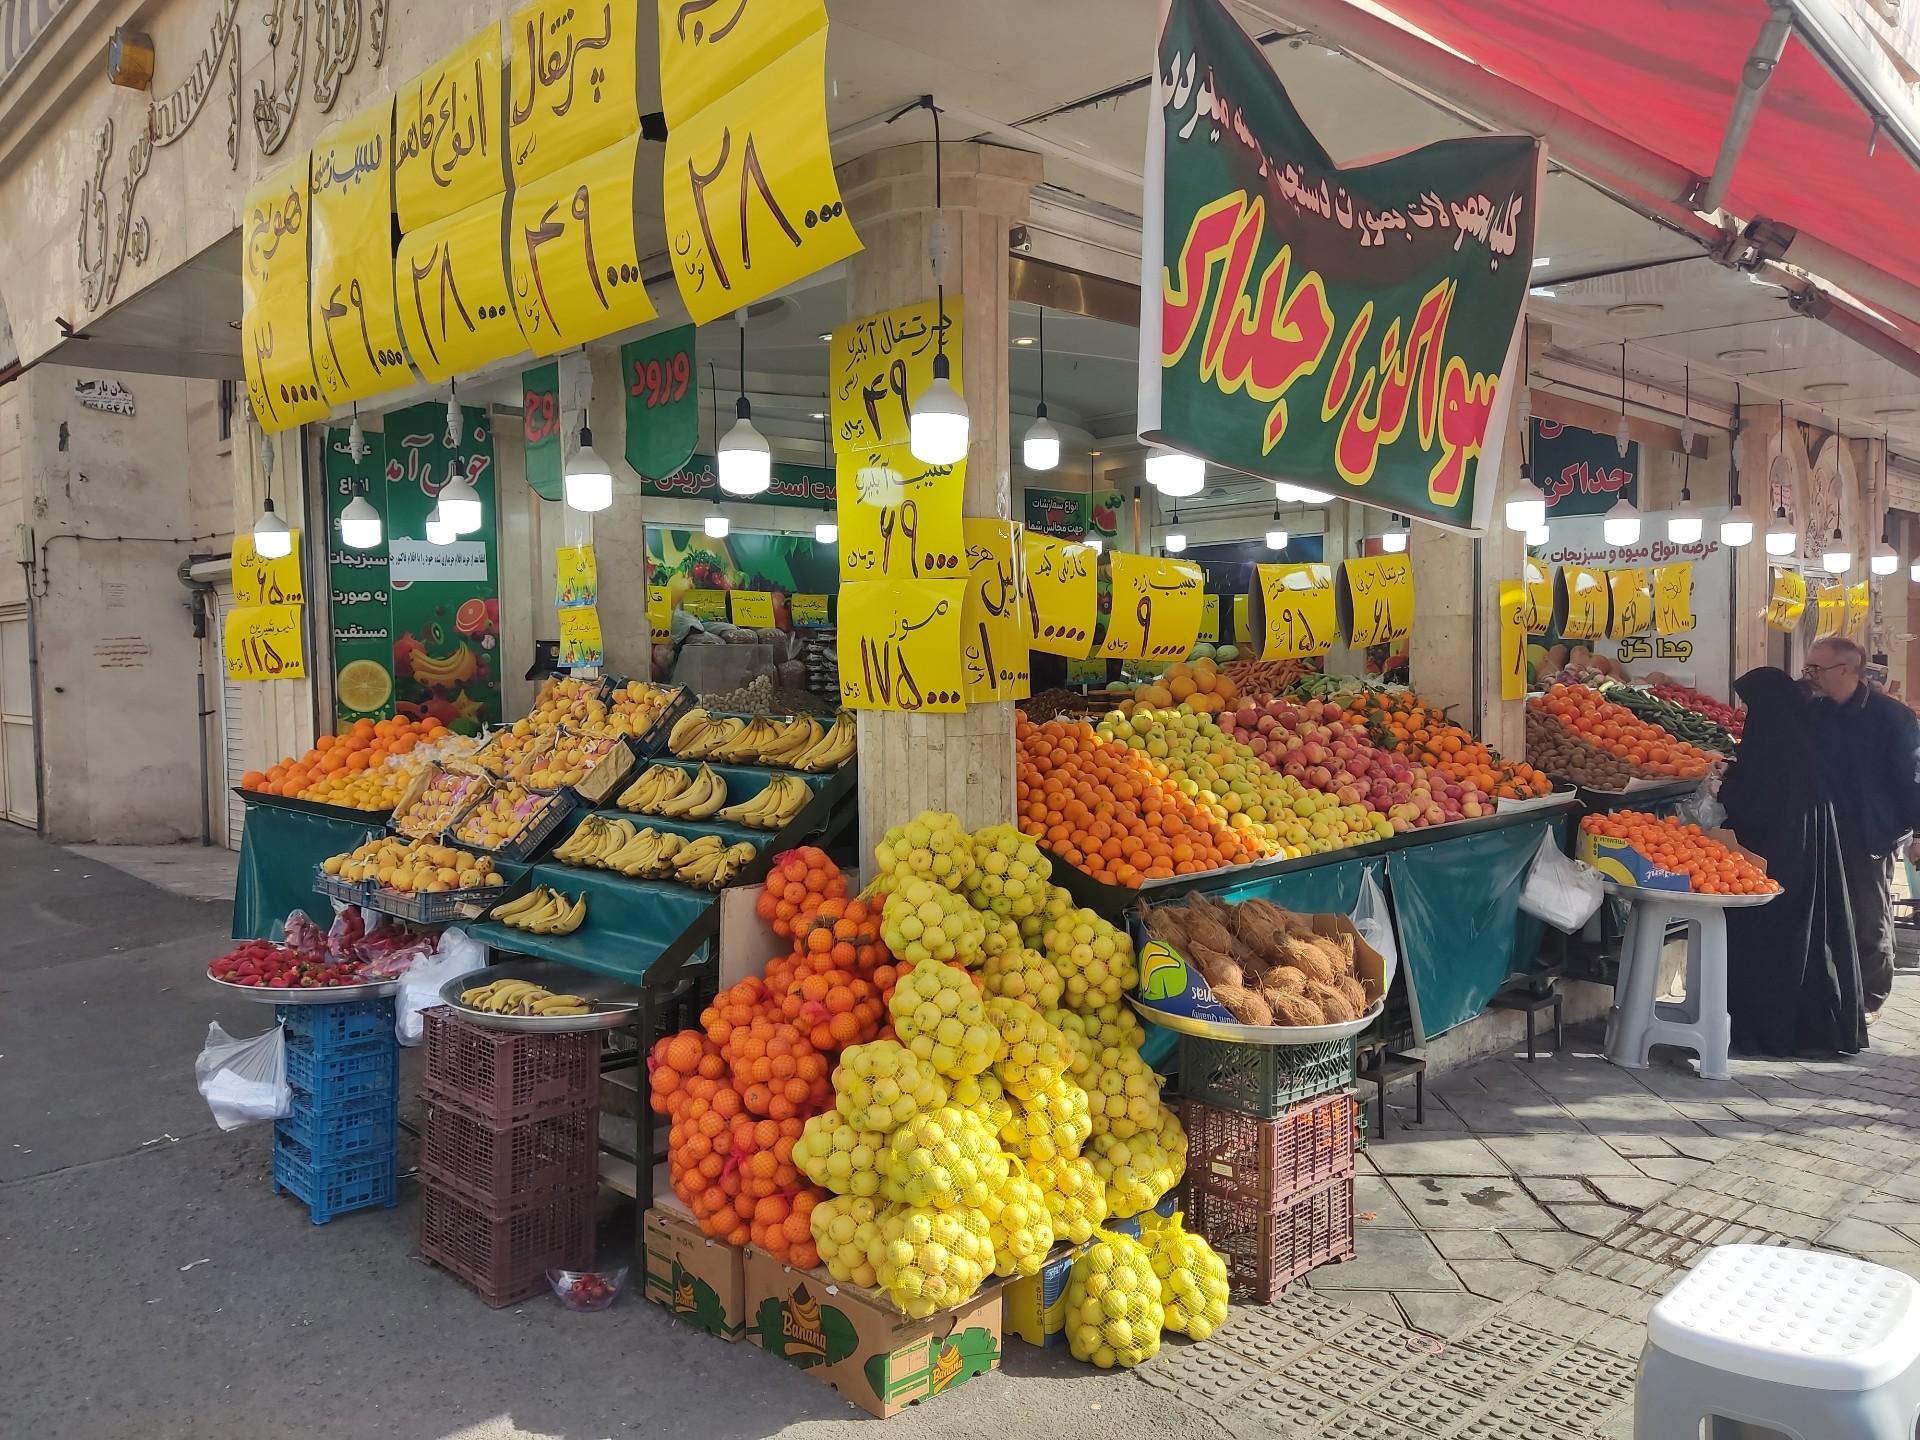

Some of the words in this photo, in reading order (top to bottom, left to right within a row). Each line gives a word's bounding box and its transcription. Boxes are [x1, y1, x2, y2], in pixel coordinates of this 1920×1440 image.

[249, 184, 302, 282] هویج
[631, 351, 691, 409] ورود
[1032, 498, 1065, 512] سفارشات
[1065, 500, 1079, 515] انواع
[1028, 519, 1043, 532] شما
[1043, 522, 1067, 534] مجالس
[1068, 524, 1084, 536] جهت
[330, 550, 388, 568] سبزیجات
[1550, 547, 1607, 565] سبزیجات
[1609, 550, 1617, 563] و
[1619, 546, 1649, 563] میوه
[1651, 543, 1679, 562] انواع
[332, 589, 371, 605] صورت
[375, 590, 388, 606] به
[888, 599, 949, 642] موز
[1617, 638, 1653, 663] کن
[1656, 638, 1694, 664] جدا
[781, 1310, 828, 1351] Banana
[932, 1359, 964, 1385] Banana
